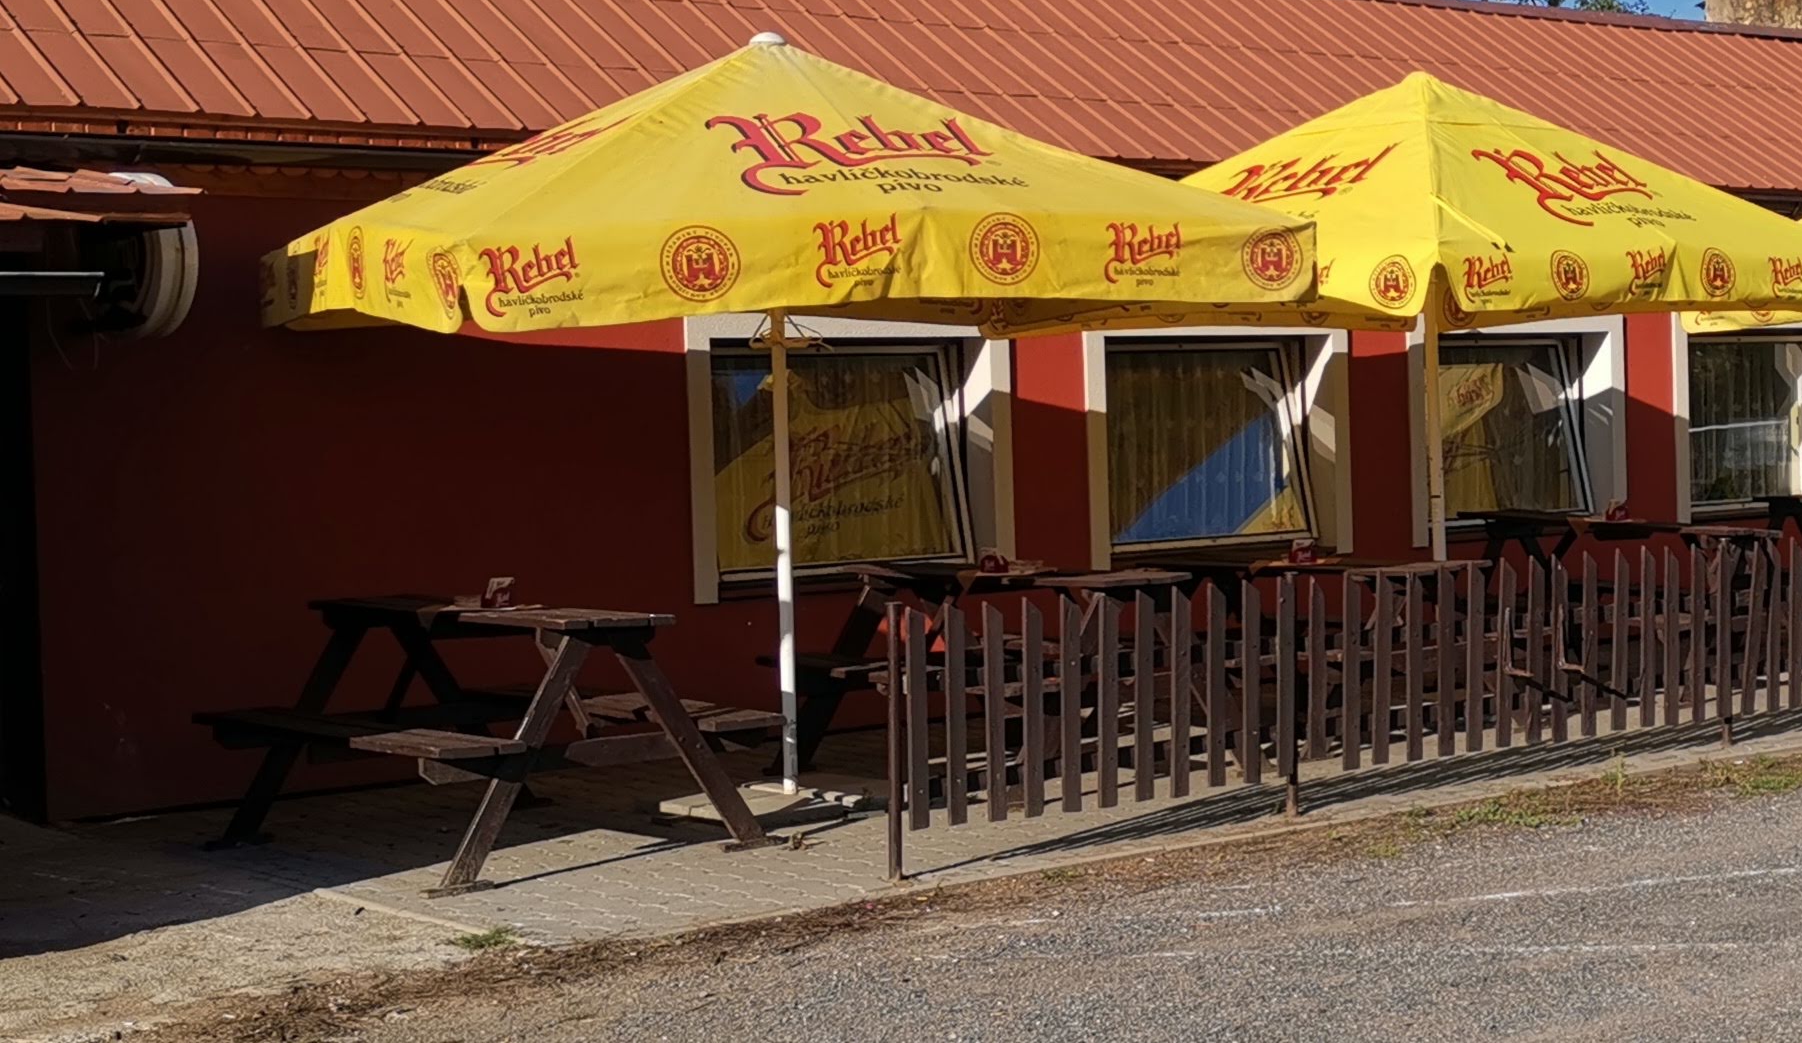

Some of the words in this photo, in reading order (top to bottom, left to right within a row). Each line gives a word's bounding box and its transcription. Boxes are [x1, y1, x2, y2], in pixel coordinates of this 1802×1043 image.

[704, 112, 994, 196] Rebel
[779, 165, 1030, 189] havlíčkobrodské
[1220, 140, 1404, 203] Rebel
[876, 181, 943, 194] pivo
[1471, 148, 1653, 227] Rebel
[478, 235, 580, 317] Rebel
[813, 211, 902, 288] Rebel
[1105, 222, 1184, 284] Rebel
[1463, 252, 1512, 304] Rebel
[529, 306, 551, 318] pivo
